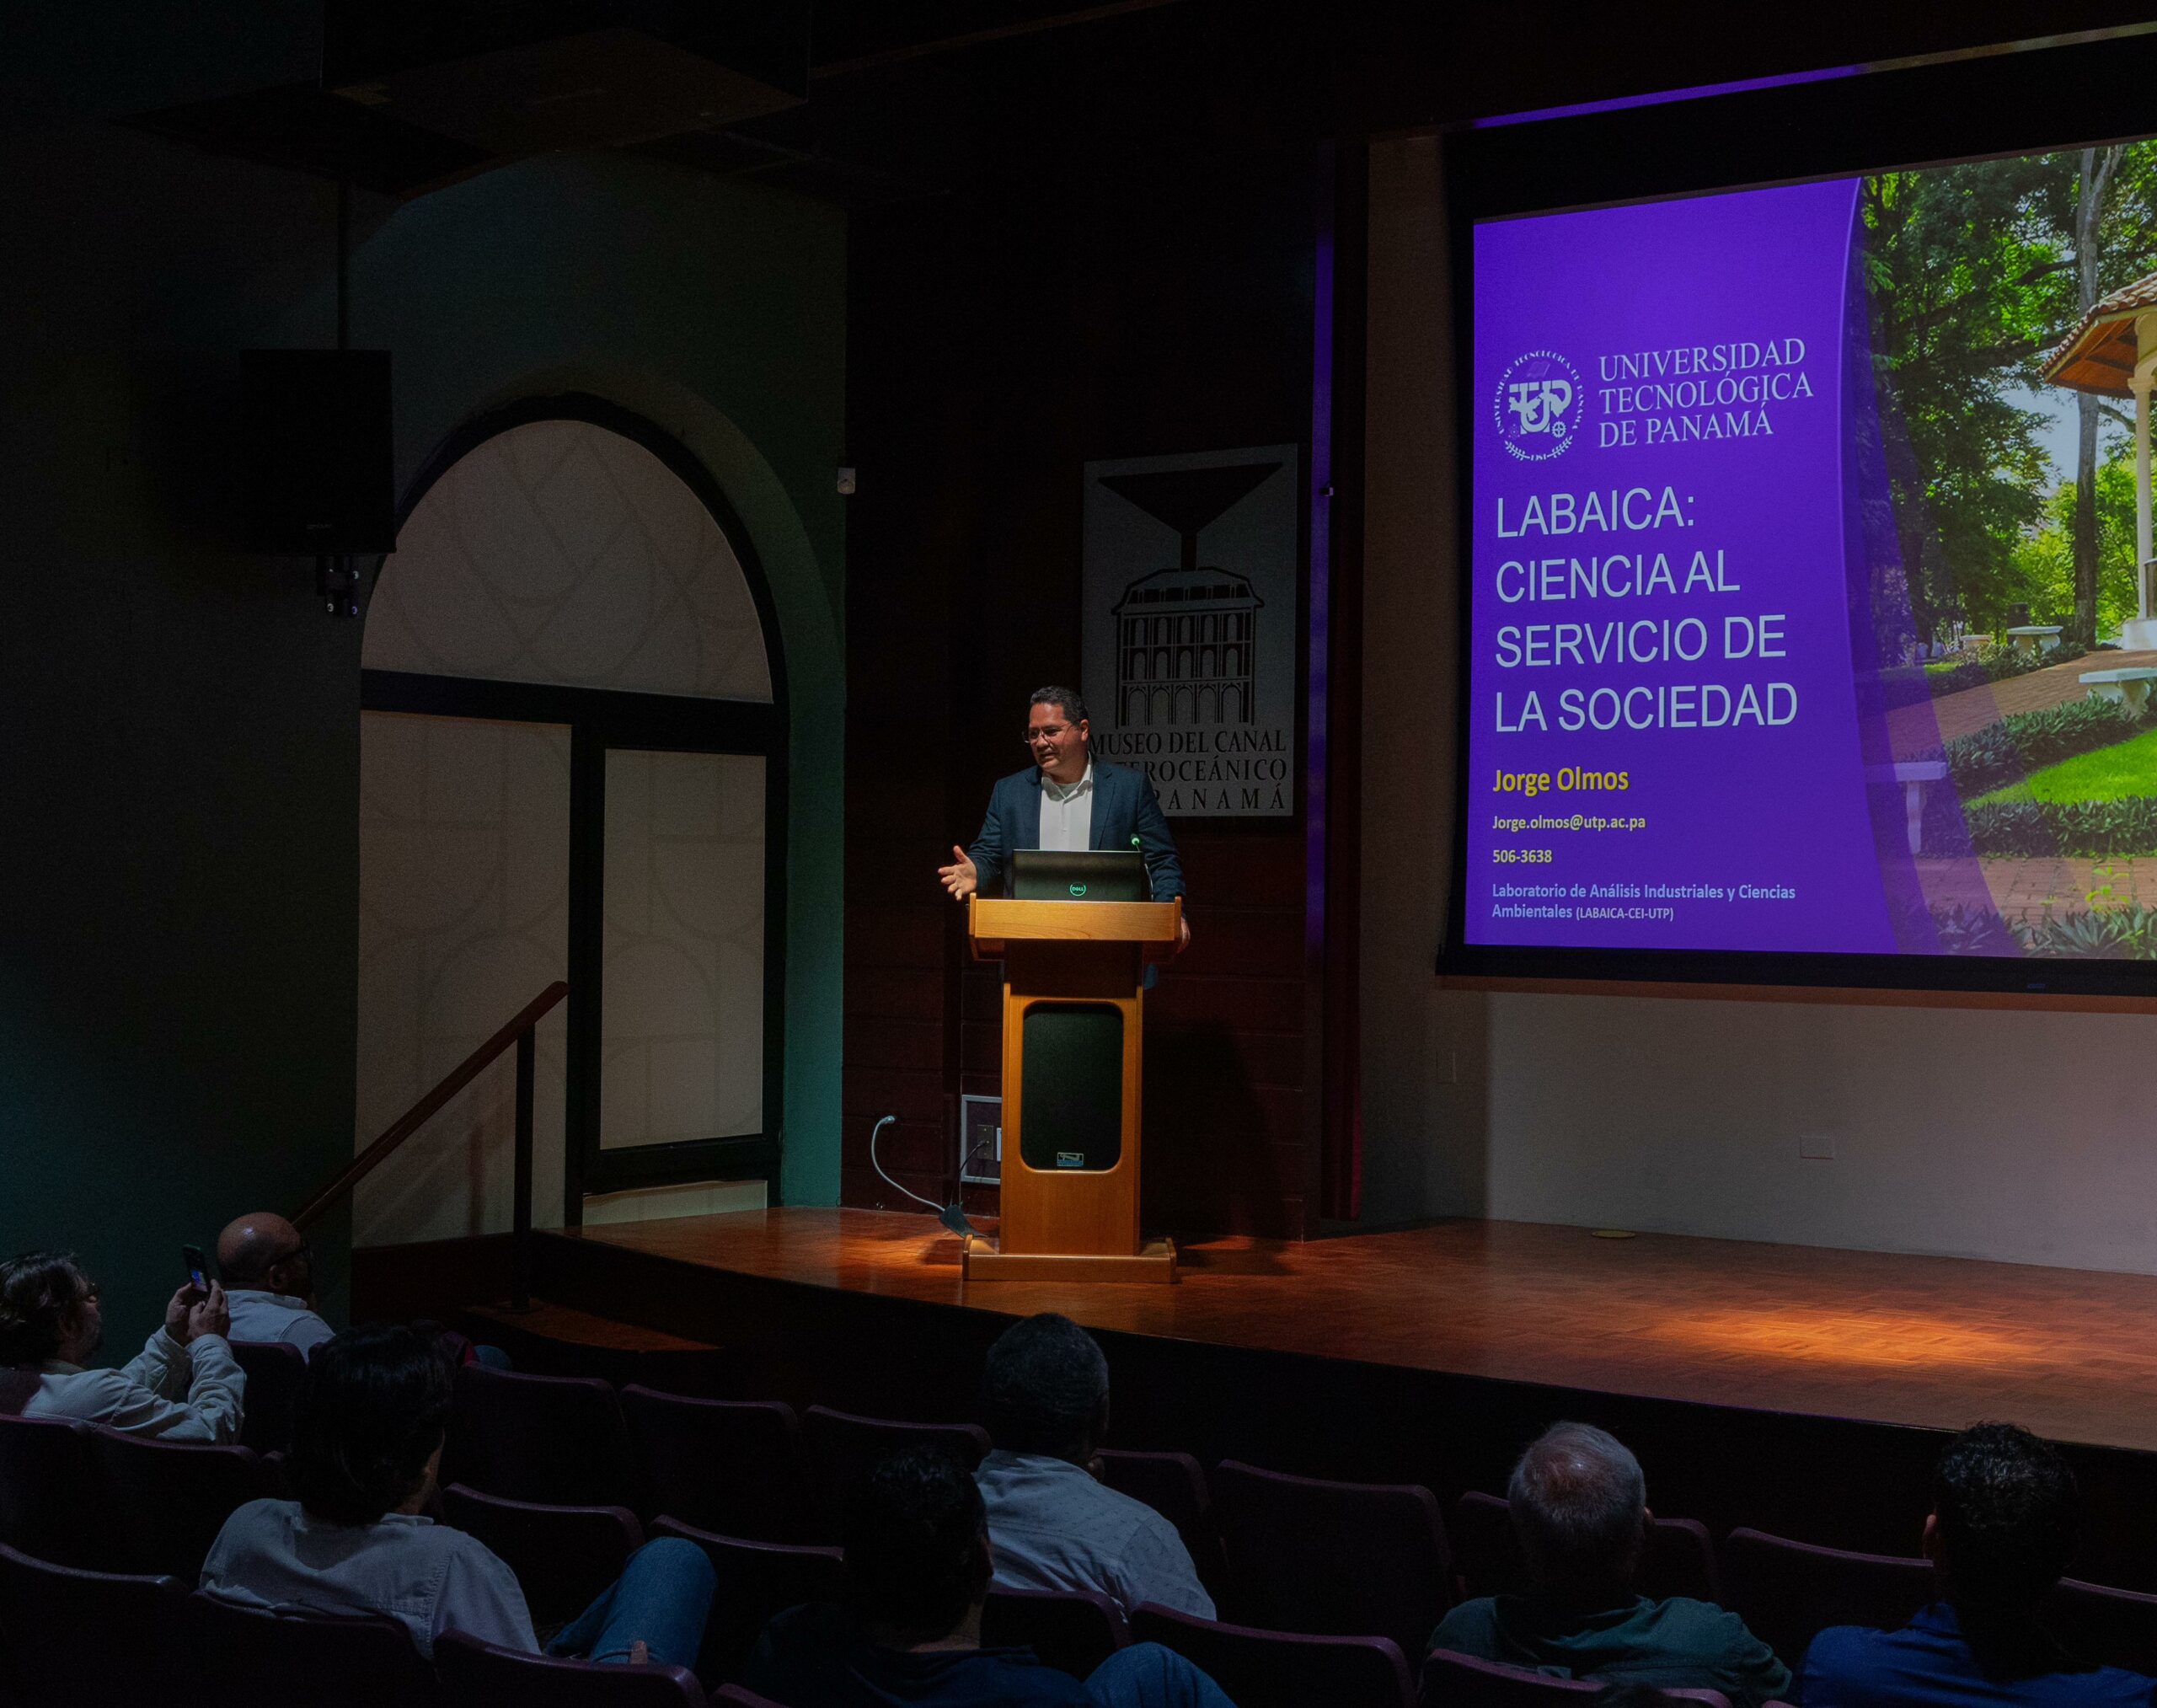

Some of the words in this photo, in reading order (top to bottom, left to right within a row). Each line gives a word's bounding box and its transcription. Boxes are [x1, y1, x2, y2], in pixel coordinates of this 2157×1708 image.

[1598, 337, 1806, 382] UNIVERSIDAD
[1598, 371, 1814, 414] TECNOLÓGICA
[1598, 419, 1637, 448] DE
[1646, 402, 1774, 444] PANAMÁ
[1497, 486, 1694, 538] LABAICA:
[1496, 553, 1677, 602] CIENCIA
[1683, 549, 1741, 593] AL
[1496, 618, 1708, 667] SERVICIO
[1724, 614, 1786, 659] DE
[1496, 690, 1548, 732] LA
[1558, 683, 1798, 731] SOCIEDAD
[1089, 732, 1162, 755] MUSEO
[1169, 731, 1209, 754] DEL
[1214, 730, 1287, 753] CANAL
[1116, 755, 1287, 782] ROCEÁNICO
[1492, 769, 1550, 796] Jorge
[1557, 767, 1630, 790] Olmos
[1492, 814, 1646, 832] Jorge.olmos@utp.ac.pa
[1492, 849, 1553, 864] 506-3638
[1492, 883, 1567, 898] Laboratorio
[1570, 884, 1587, 897] de
[1589, 883, 1641, 898] Análisis
[1644, 884, 1724, 899] Industriales
[1726, 887, 1736, 902] y
[1738, 885, 1796, 899] Ciencias
[1492, 903, 1573, 918] Ambientales
[1576, 907, 1675, 922] (LABAICA-CEI-UTP)
